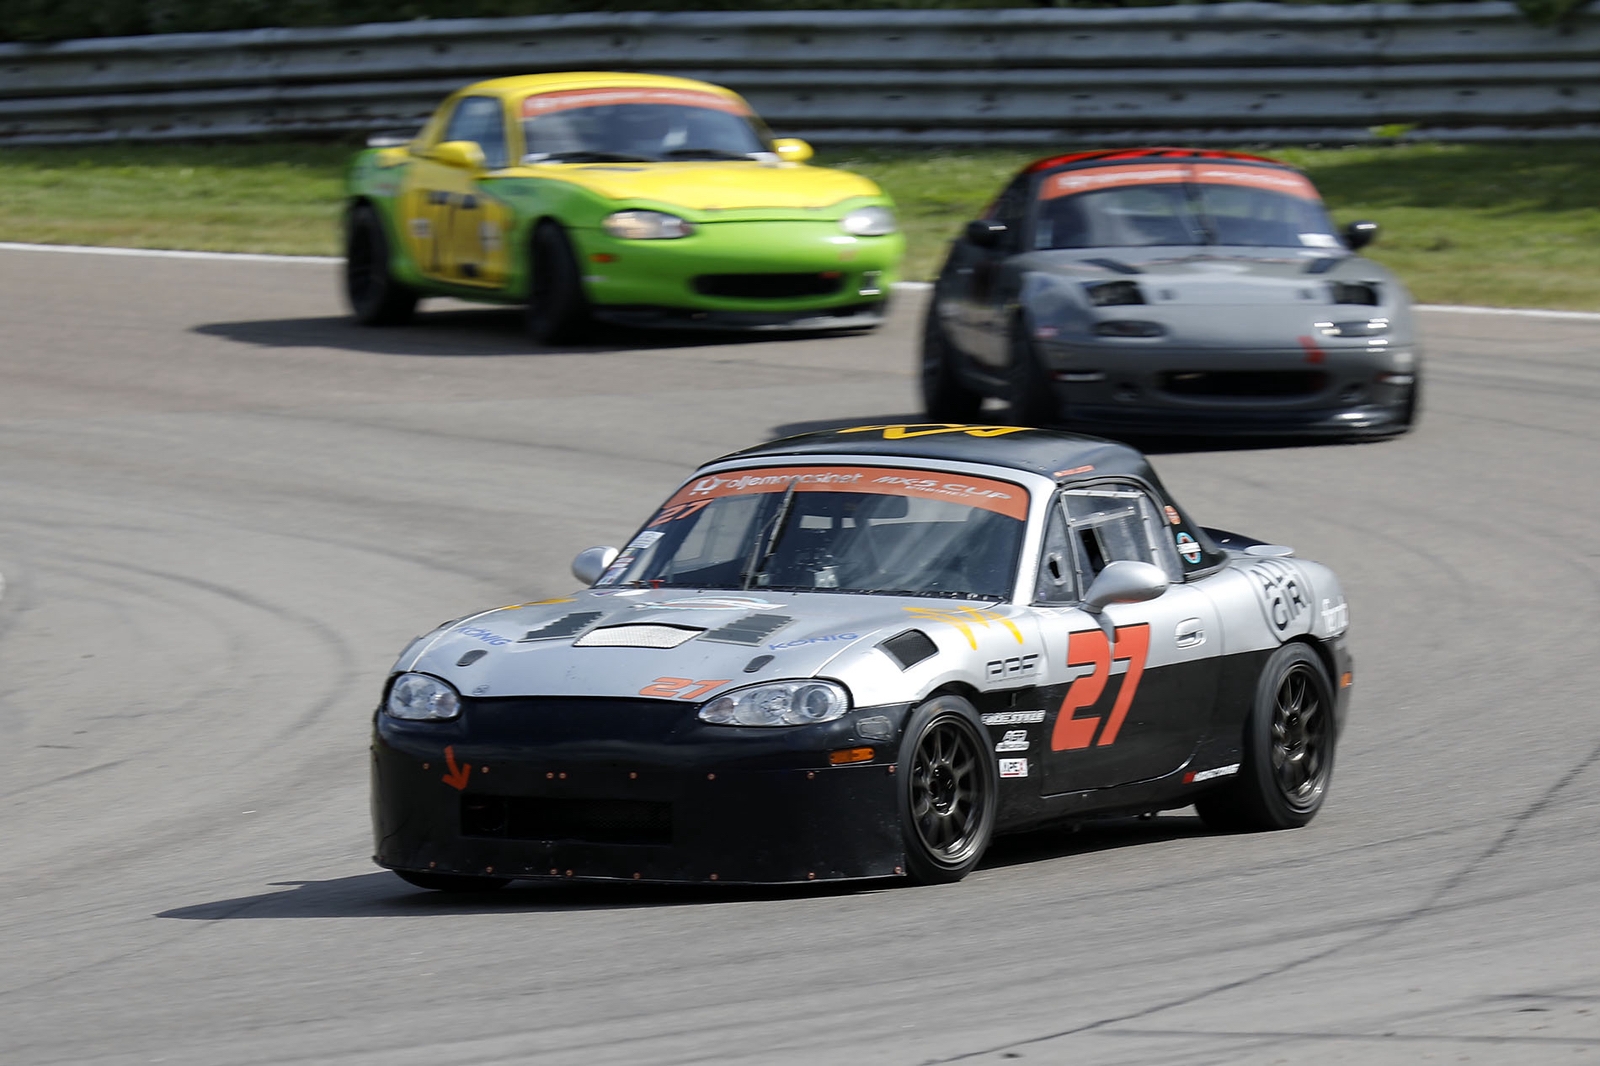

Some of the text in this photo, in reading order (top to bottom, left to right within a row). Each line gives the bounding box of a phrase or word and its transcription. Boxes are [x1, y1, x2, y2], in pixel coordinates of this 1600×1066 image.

[943, 483, 1012, 500] CUP
[639, 676, 732, 699] 27
[1051, 622, 1149, 752] 27
